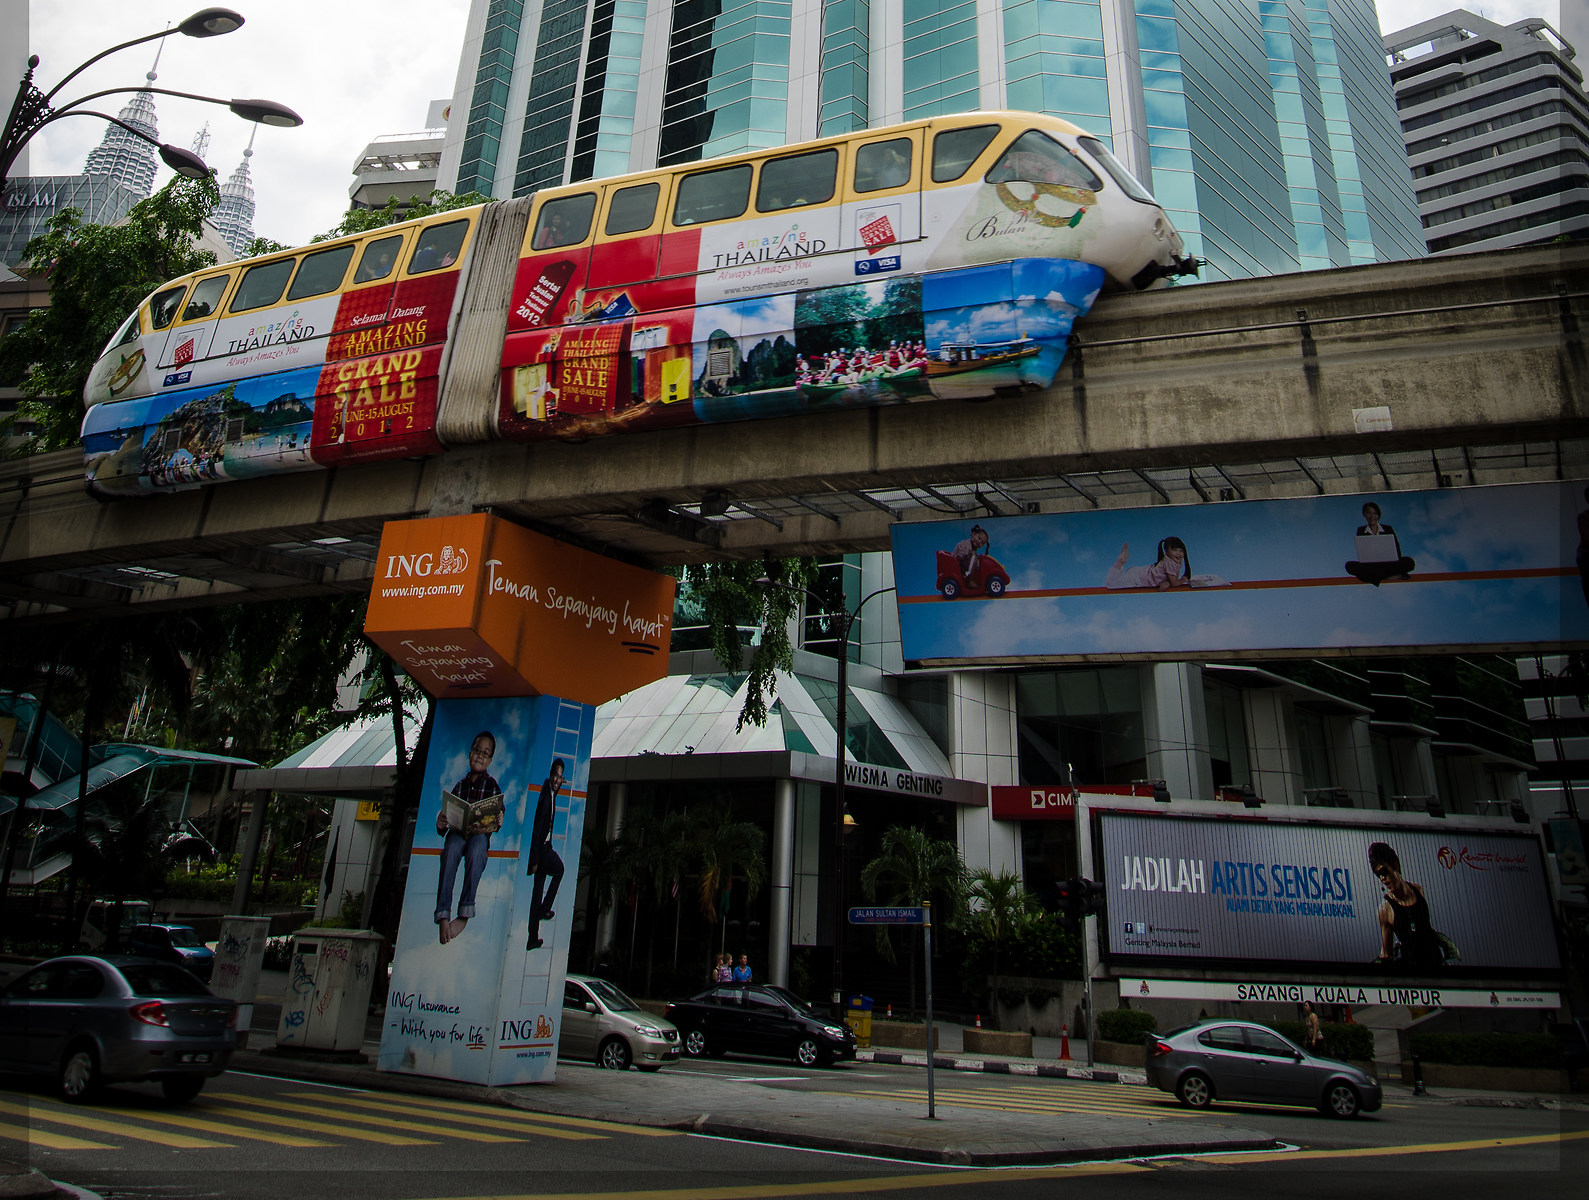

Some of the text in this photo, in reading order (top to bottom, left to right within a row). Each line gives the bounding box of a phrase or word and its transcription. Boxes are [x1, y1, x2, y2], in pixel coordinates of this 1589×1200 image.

[8, 192, 57, 207] ISLAM
[736, 223, 808, 251] amazing
[713, 239, 826, 268] THAILAND
[877, 257, 897, 267] VISA
[717, 259, 812, 281] Always Amazes You
[533, 285, 554, 301] Jualan
[538, 275, 561, 293] Sertai
[723, 277, 809, 295] www.tourismthailand.org
[350, 305, 426, 326] Selamat Datang
[516, 305, 540, 326] 2012
[524, 298, 545, 314] Thailand
[248, 311, 303, 337] amazing
[346, 319, 428, 345] AMAZING
[228, 325, 315, 353] THAILAND
[345, 332, 427, 358] THAILAND
[564, 340, 609, 349] AMAZING
[226, 345, 300, 368] Always Amazes You
[563, 349, 608, 357] THAILAND
[563, 357, 609, 369] GRAND
[338, 351, 423, 382] GRAND
[562, 368, 608, 388] SALE
[333, 371, 417, 410] SALE
[377, 401, 415, 418] AUGUST
[384, 553, 433, 579] ING
[381, 584, 465, 599] www.ing.com.my
[484, 559, 664, 641] Teman Sepanjang hayat
[400, 639, 466, 655] Teman
[431, 668, 487, 684] hayat
[845, 764, 943, 796] WISMA GENTING
[1121, 855, 1353, 902] JADILAH ARTIS SENSASI
[1499, 865, 1529, 873] GENTING
[855, 909, 917, 917] JALAN SULTAN ISMAIL
[1226, 898, 1356, 918] ALAMI DETIK YANG MENAKJUBKAN.
[1125, 937, 1201, 949] Genting Malaysia Berhad
[391, 991, 461, 1015] ING Insurance
[1237, 984, 1442, 1006] SAYANGI KUALA LUMPUR
[400, 1017, 427, 1040] With
[429, 1029, 446, 1044] you
[449, 1023, 465, 1044] for
[468, 1025, 484, 1045] life
[500, 1019, 532, 1041] ING
[516, 1051, 551, 1059] www.ing.com.my
